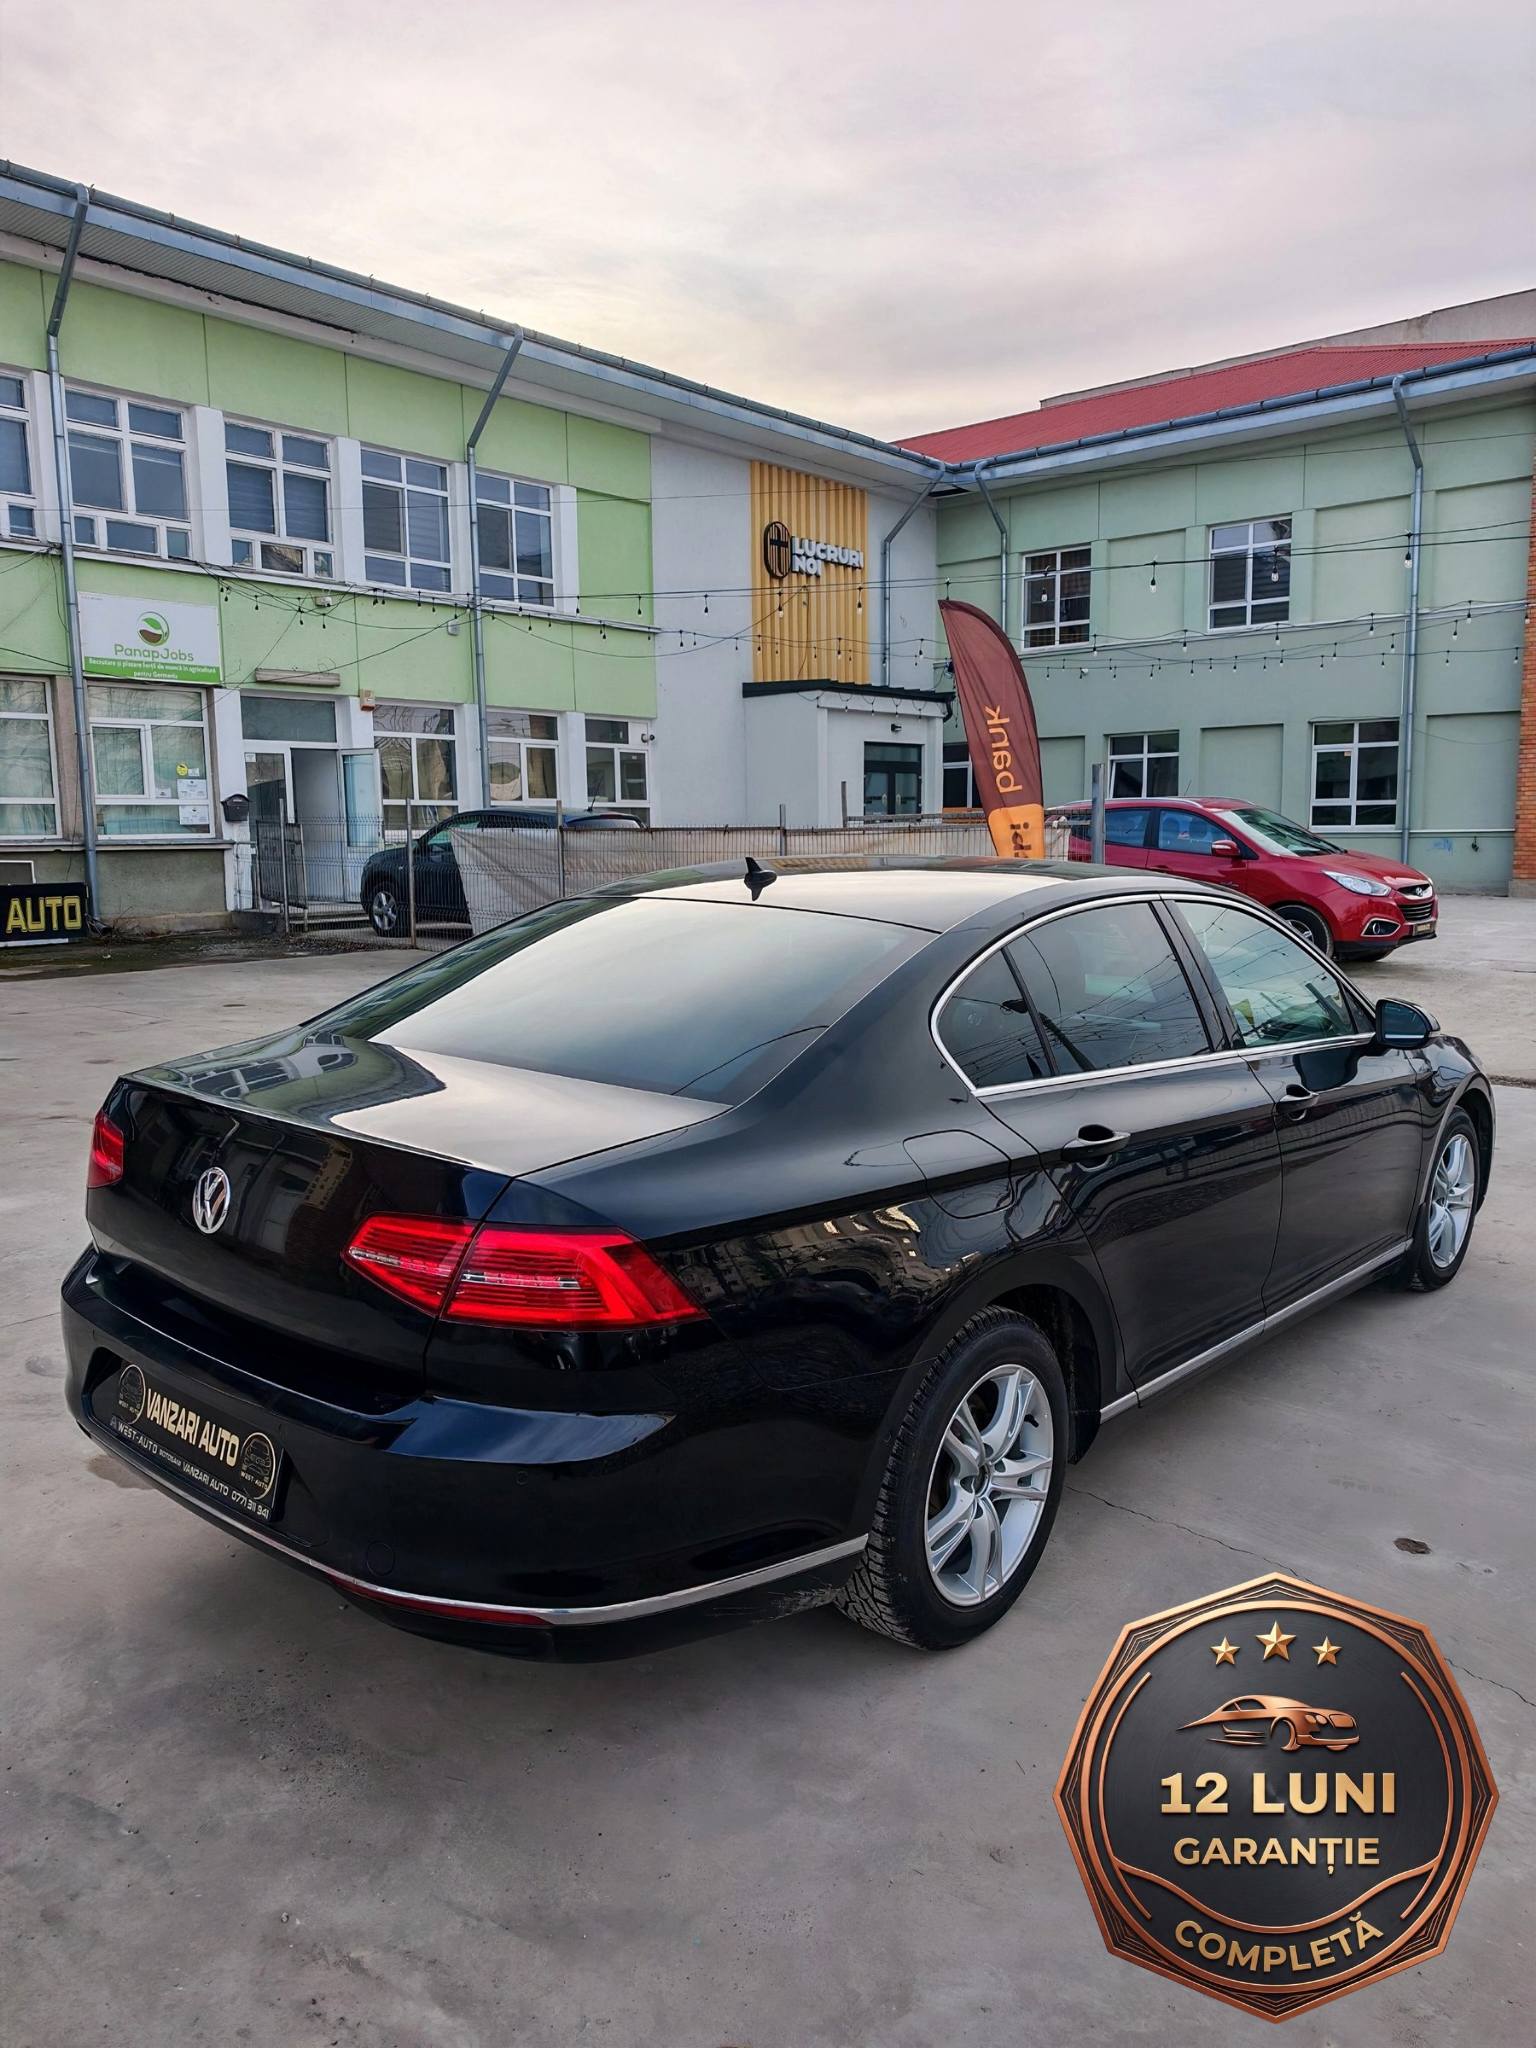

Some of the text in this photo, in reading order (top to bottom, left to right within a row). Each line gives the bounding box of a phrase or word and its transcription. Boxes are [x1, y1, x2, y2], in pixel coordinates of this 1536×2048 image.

[791, 536, 864, 570] LUCRURI
[791, 555, 822, 577] NOI
[114, 643, 194, 661] PanapJobs
[6, 896, 82, 933] AUTO
[146, 1388, 240, 1468] VANZARI AUTO
[183, 1461, 210, 1486] VANZARI
[209, 1478, 229, 1496] AUTO
[257, 1505, 270, 1519] 941
